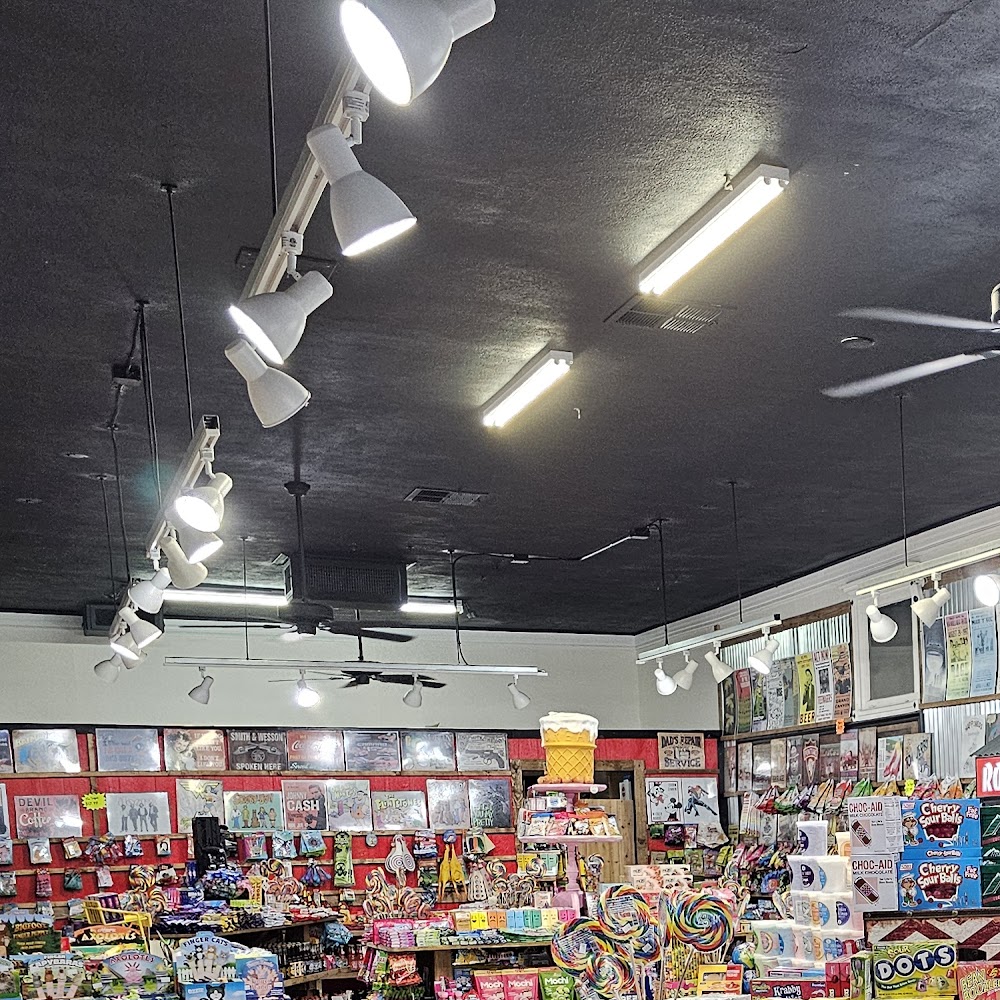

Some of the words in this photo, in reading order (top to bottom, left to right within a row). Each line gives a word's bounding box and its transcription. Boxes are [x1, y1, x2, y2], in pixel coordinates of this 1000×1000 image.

[799, 712, 815, 724] BEER
[230, 732, 251, 741] SMITH
[661, 735, 680, 749] DAD'S
[680, 735, 702, 748] REPAIR
[236, 762, 263, 770] SPOKEN
[264, 762, 282, 770] HERE
[664, 758, 701, 768] SERVICE
[19, 798, 53, 807] DEVIL
[287, 800, 320, 811] CASH
[849, 801, 883, 813] CHOC-AID
[921, 802, 960, 817] Cherry
[966, 806, 978, 814] Fat
[919, 813, 941, 827] Sour
[941, 811, 963, 825] Balls
[965, 812, 979, 820] Free
[852, 859, 893, 870] CHOC-AID
[919, 862, 957, 877] Cherry
[965, 865, 978, 873] Fat
[917, 873, 939, 886] Sour
[939, 871, 962, 885] Balls
[964, 871, 979, 880] Free
[183, 936, 210, 947] FINGER
[211, 936, 229, 947] CATS
[887, 946, 911, 959] SOUR
[873, 943, 958, 983] DOTS
[507, 979, 533, 988] Mochi
[544, 976, 569, 985] Mochi
[959, 967, 987, 989] BEAN
[480, 980, 504, 989] Moch
[772, 984, 802, 997] Krabby
